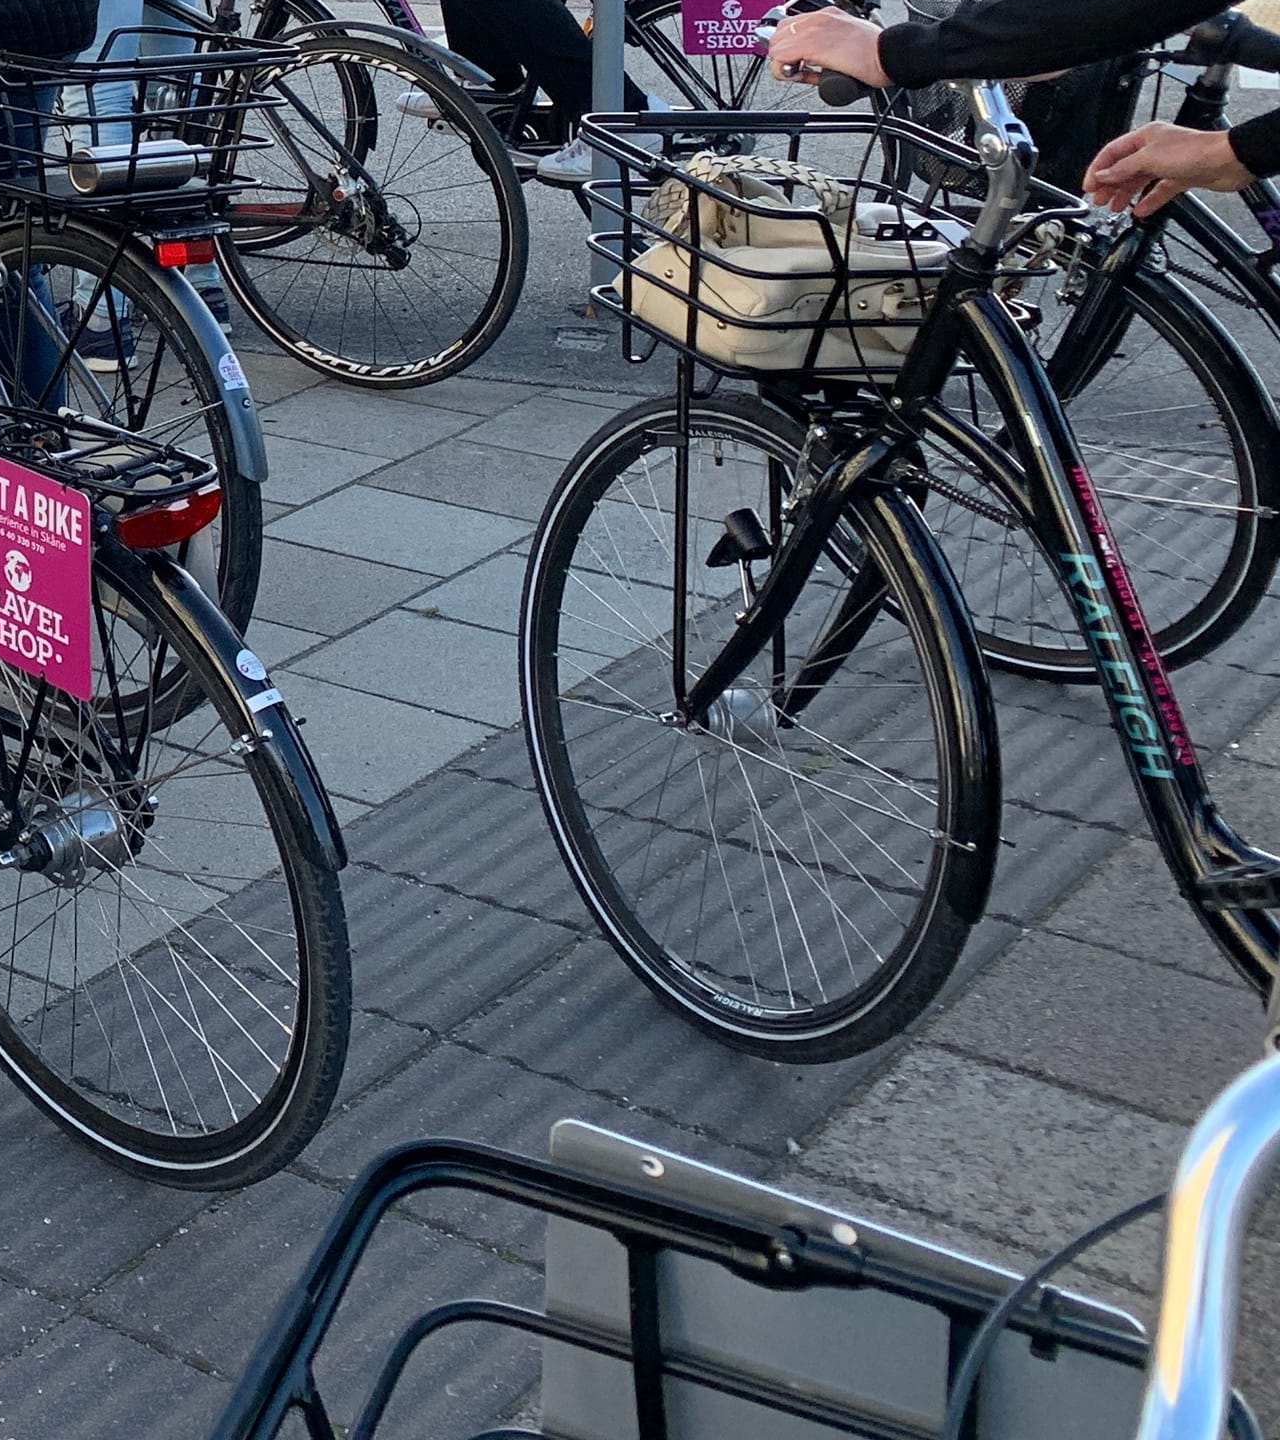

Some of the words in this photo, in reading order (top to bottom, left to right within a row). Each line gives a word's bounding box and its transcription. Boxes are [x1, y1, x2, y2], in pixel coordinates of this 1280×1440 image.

[694, 20, 760, 34] TRAVE
[13, 484, 29, 521] A
[33, 491, 83, 546] BIKE
[6, 530, 16, 541] 40
[31, 541, 45, 555] 570
[30, 526, 40, 539] in
[40, 530, 67, 552] Skåne
[1058, 551, 1175, 781] RALEIGH
[713, 993, 764, 1017] RALEIGH
